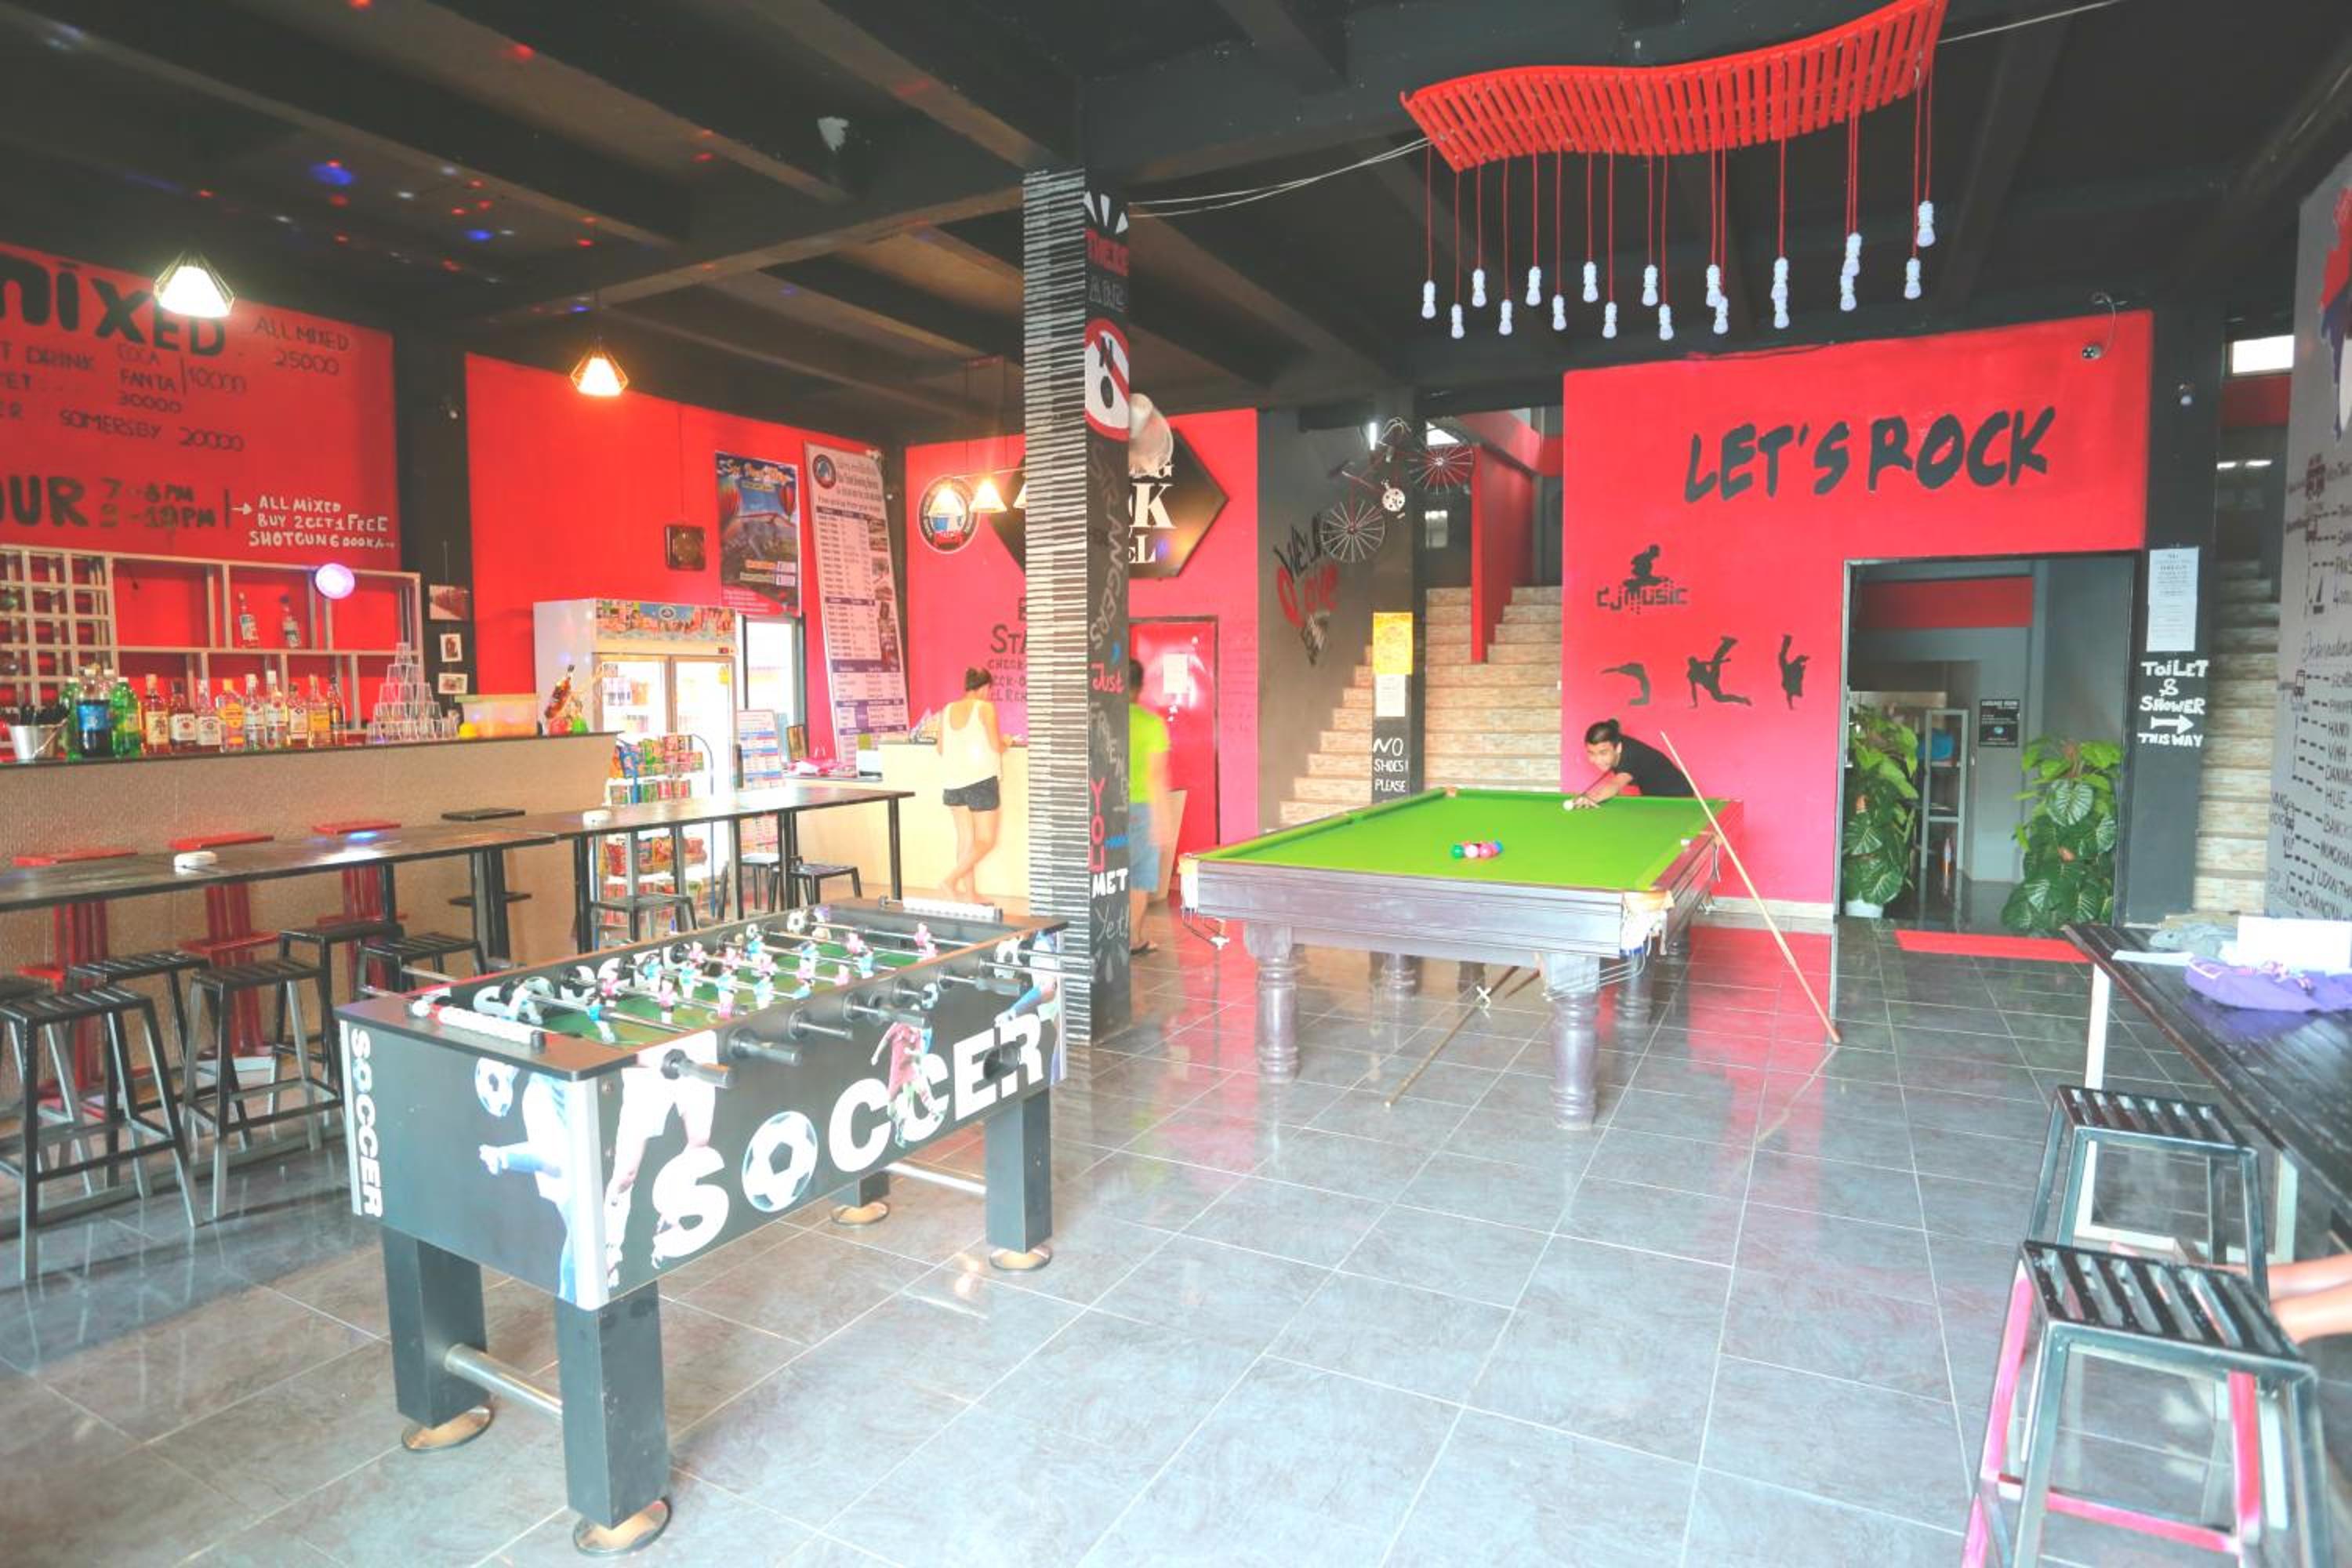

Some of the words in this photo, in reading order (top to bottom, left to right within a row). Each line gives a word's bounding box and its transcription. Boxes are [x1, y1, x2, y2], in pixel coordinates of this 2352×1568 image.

[1685, 422, 1852, 504] LET'S
[1867, 405, 2056, 492] ROCK
[260, 495, 289, 510] ALL
[257, 514, 286, 528] BUY
[249, 531, 326, 547] SHOTGUN
[1372, 738, 1404, 757] NO
[2171, 734, 2203, 748] WAY
[1092, 868, 1129, 898] MET
[351, 1028, 383, 1218] SOCCER
